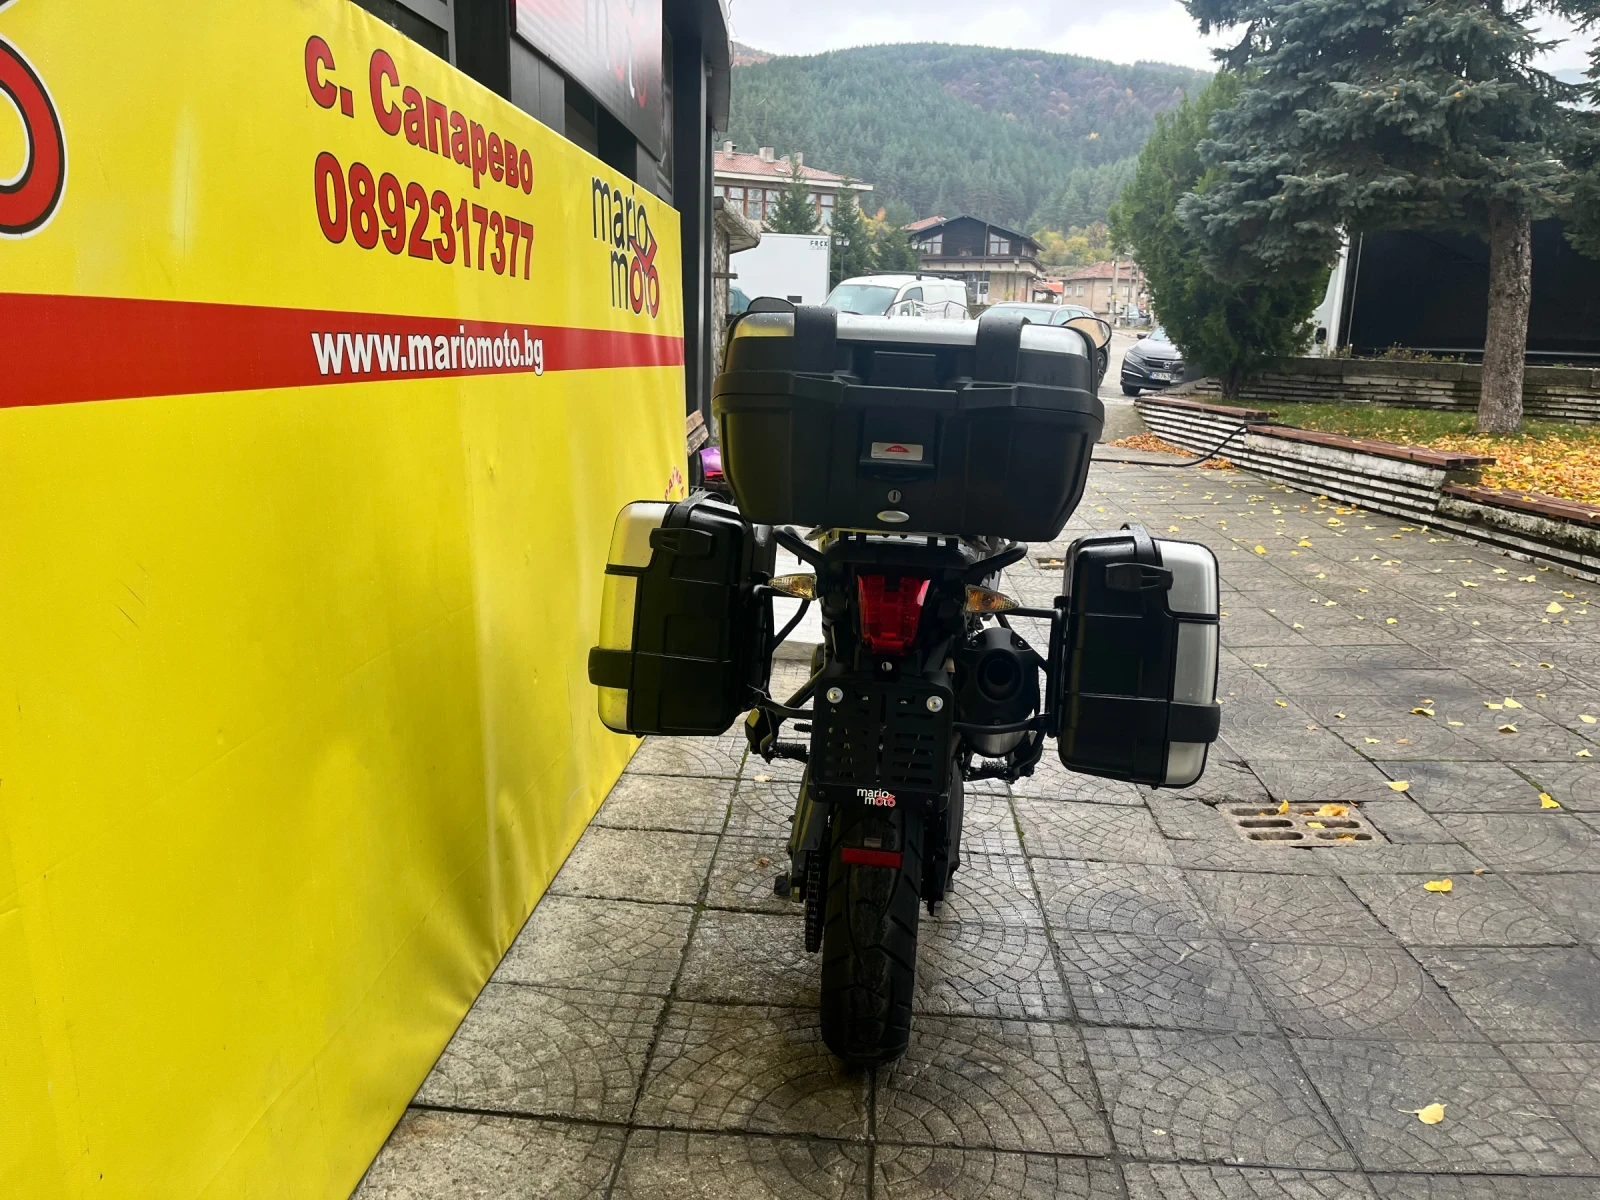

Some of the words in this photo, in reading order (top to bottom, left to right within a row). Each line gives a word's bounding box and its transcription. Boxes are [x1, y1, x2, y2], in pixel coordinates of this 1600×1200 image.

[305, 35, 354, 118] с.
[369, 48, 533, 195] Сапарево
[314, 151, 534, 280] 0892317377
[592, 176, 649, 257] mario
[610, 250, 660, 319] moto
[310, 324, 543, 376] www.mariomoto.bg
[856, 788, 889, 797] mario
[864, 796, 896, 807] moto
